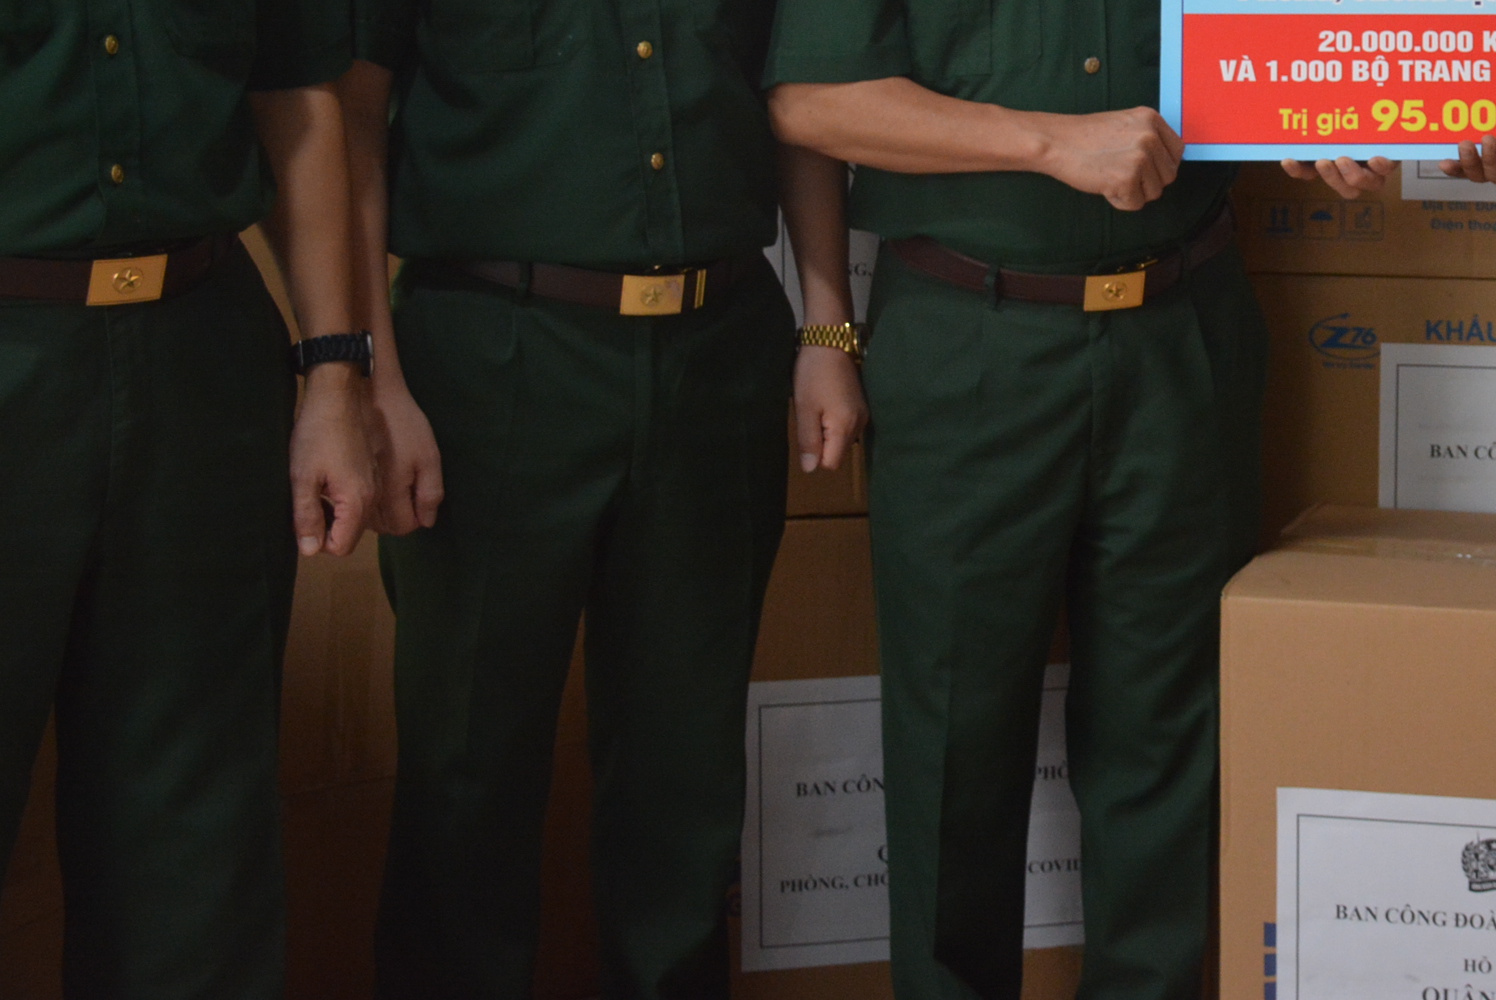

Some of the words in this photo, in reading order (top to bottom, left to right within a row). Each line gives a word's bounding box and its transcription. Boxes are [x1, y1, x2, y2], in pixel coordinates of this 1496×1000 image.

[1318, 30, 1473, 53] 20.000.000
[1219, 55, 1257, 82] VÀ
[1266, 59, 1342, 83] 1.000
[1352, 55, 1390, 87] BỘ
[1398, 59, 1491, 83] TRANG
[1279, 107, 1308, 137] Trị
[1316, 105, 1359, 137] giá
[1430, 444, 1468, 459] BAN
[796, 781, 837, 797] BAN
[843, 773, 885, 794] CÔN
[1335, 904, 1379, 922] BAN
[1385, 903, 1448, 927] CÔNG
